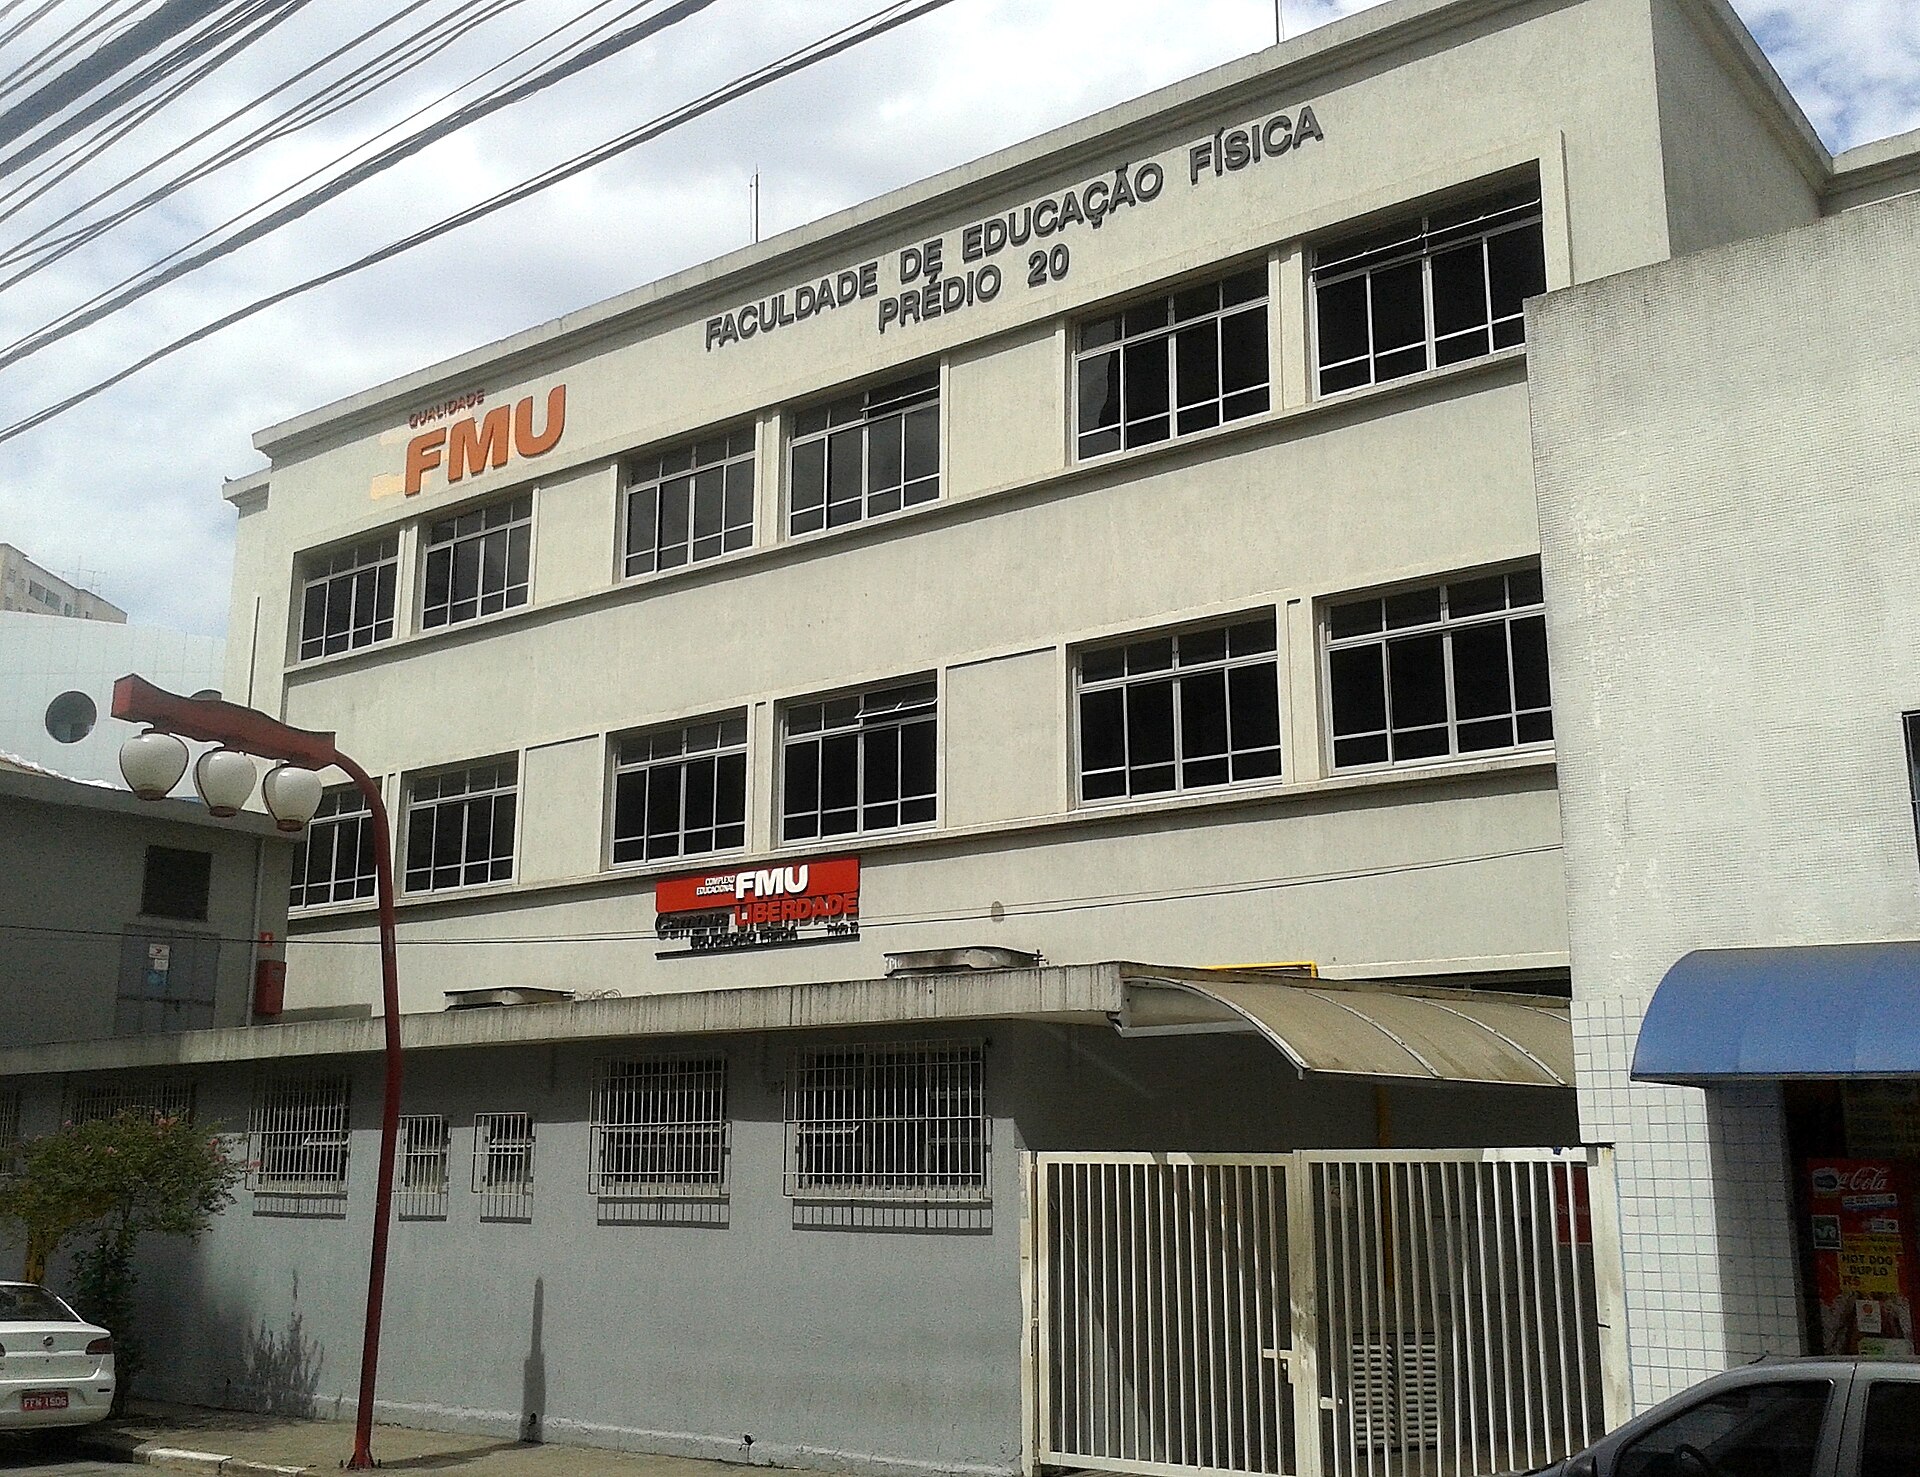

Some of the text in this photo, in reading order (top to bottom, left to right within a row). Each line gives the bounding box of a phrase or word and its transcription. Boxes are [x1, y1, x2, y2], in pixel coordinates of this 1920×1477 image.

[706, 105, 1324, 351] FACULDADE DE EDUCAÇÃO FÍSICA
[878, 243, 1070, 334] PRÉDIO 20
[408, 388, 486, 429] QUALIDADE
[404, 383, 567, 498] FMU
[735, 864, 809, 900] FMU
[734, 892, 859, 926] LIBERDADE
[1841, 1254, 1893, 1266] HOT DOG
